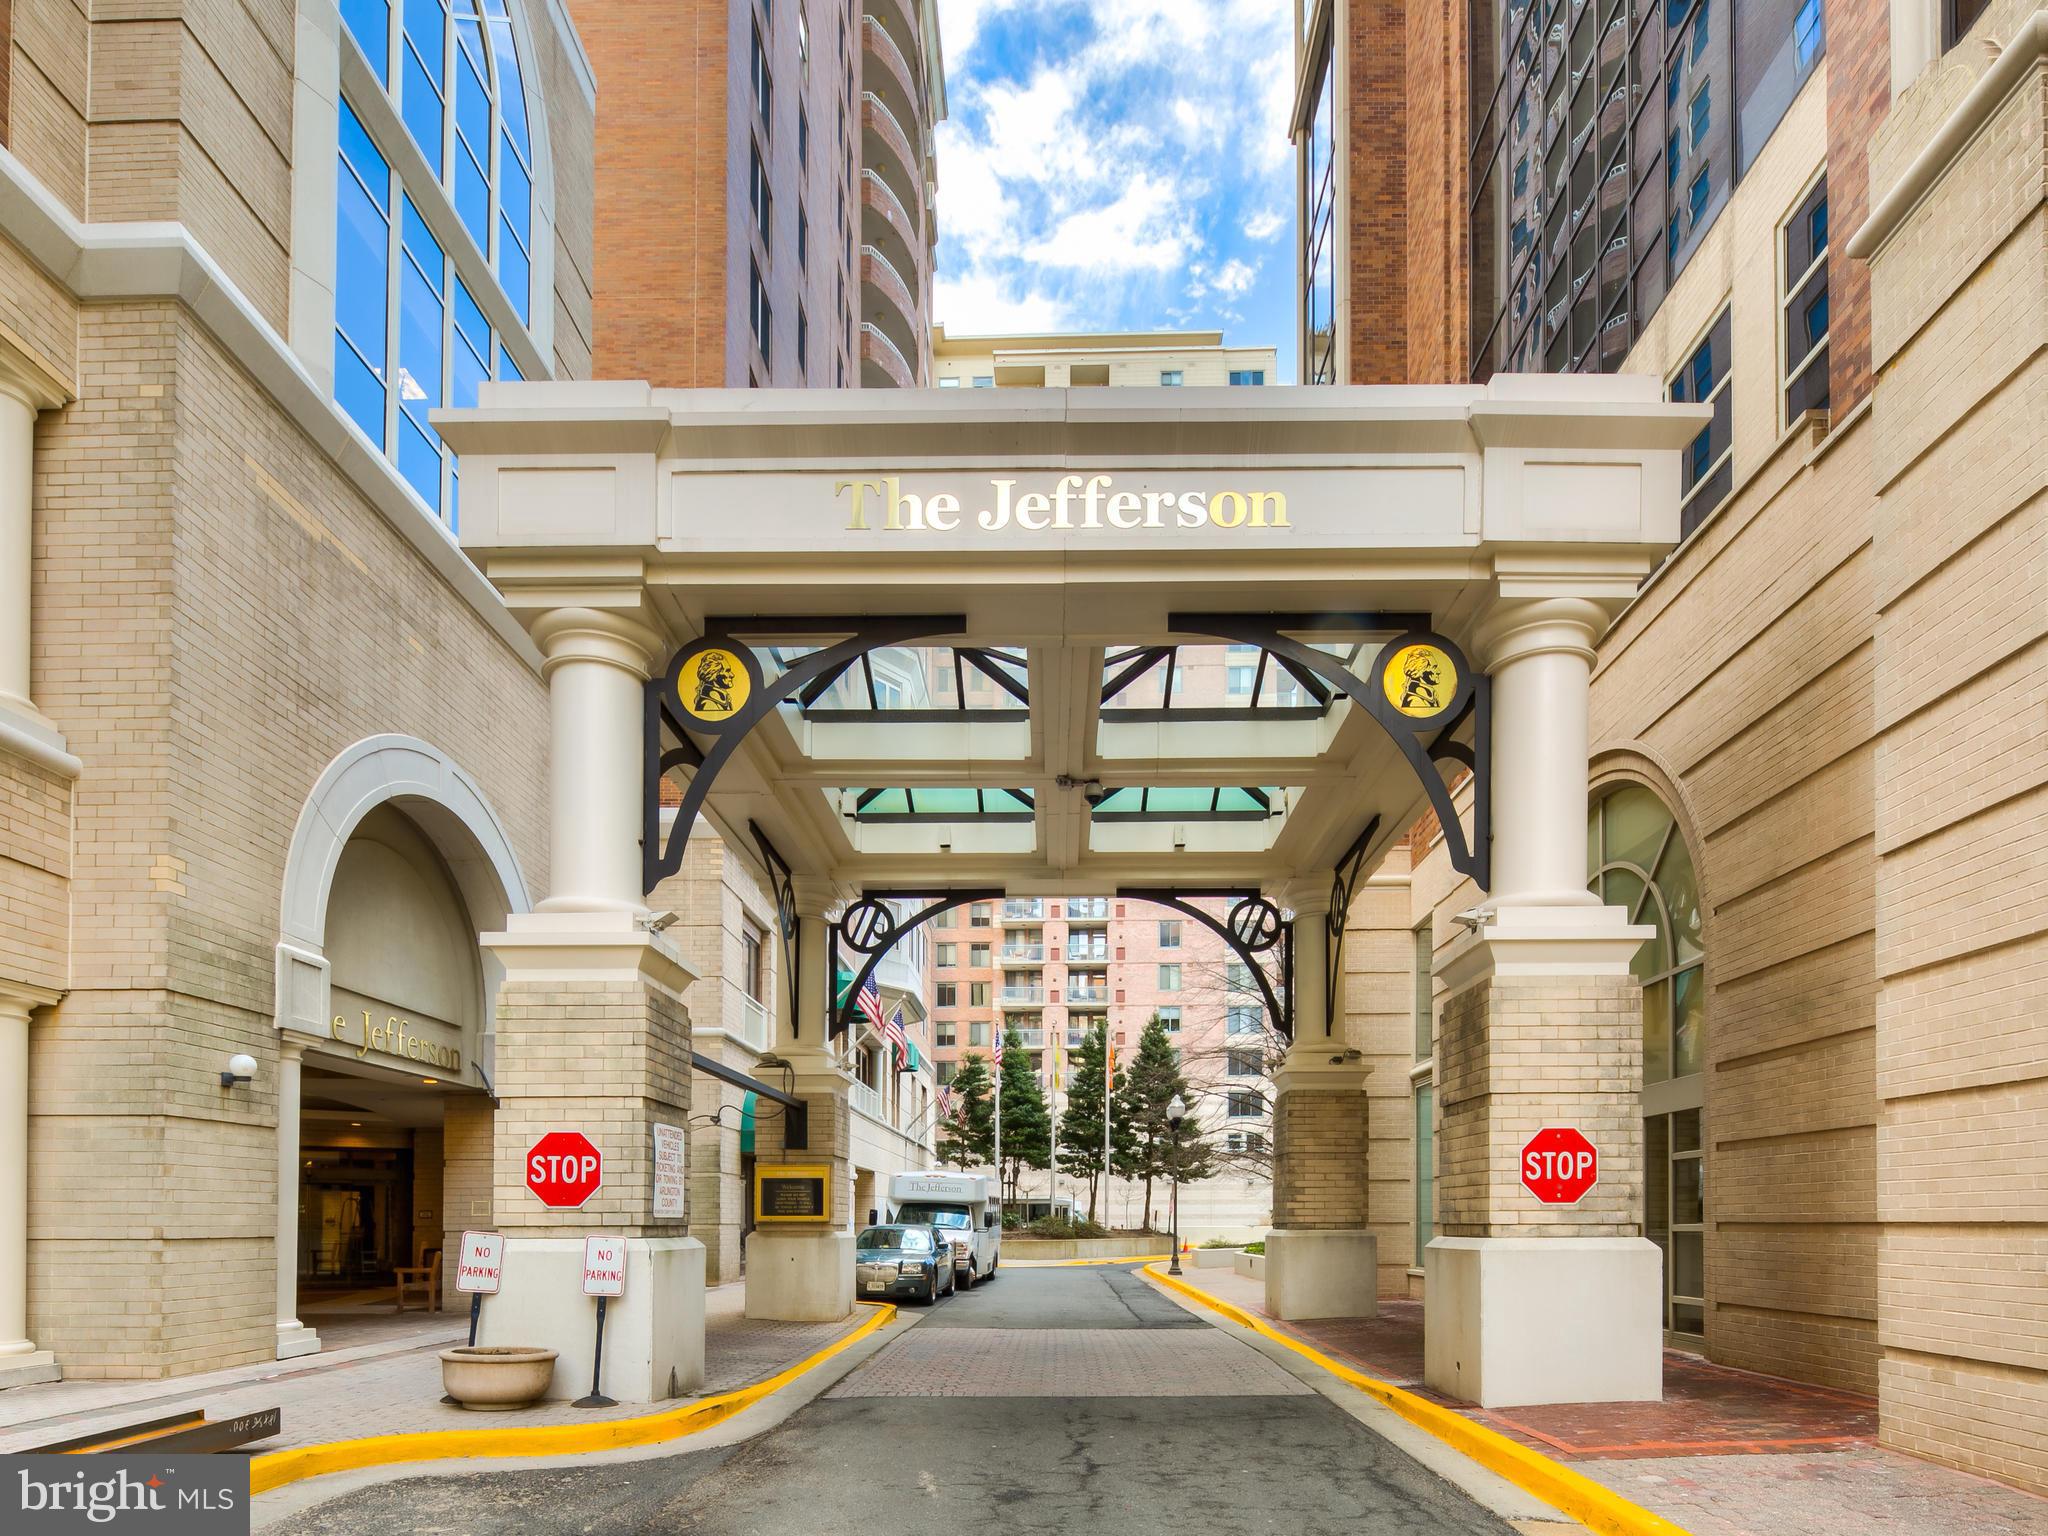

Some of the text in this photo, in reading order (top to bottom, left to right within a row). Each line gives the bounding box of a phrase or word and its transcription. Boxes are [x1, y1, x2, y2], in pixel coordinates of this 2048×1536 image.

[834, 474, 1291, 531] The Jefferson
[355, 1010, 461, 1071] Jefferson
[656, 1127, 682, 1141] UNATTENDED
[661, 1140, 680, 1151] VEHICLES
[658, 1151, 674, 1162] SUBJECT
[530, 1155, 597, 1184] STOP
[1525, 1151, 1593, 1180] STOP
[910, 1182, 962, 1193] The Jefferson
[475, 1247, 491, 1258] NO
[597, 1250, 612, 1261] NO
[461, 1266, 499, 1279] PARKING
[585, 1269, 622, 1281] PARKING
